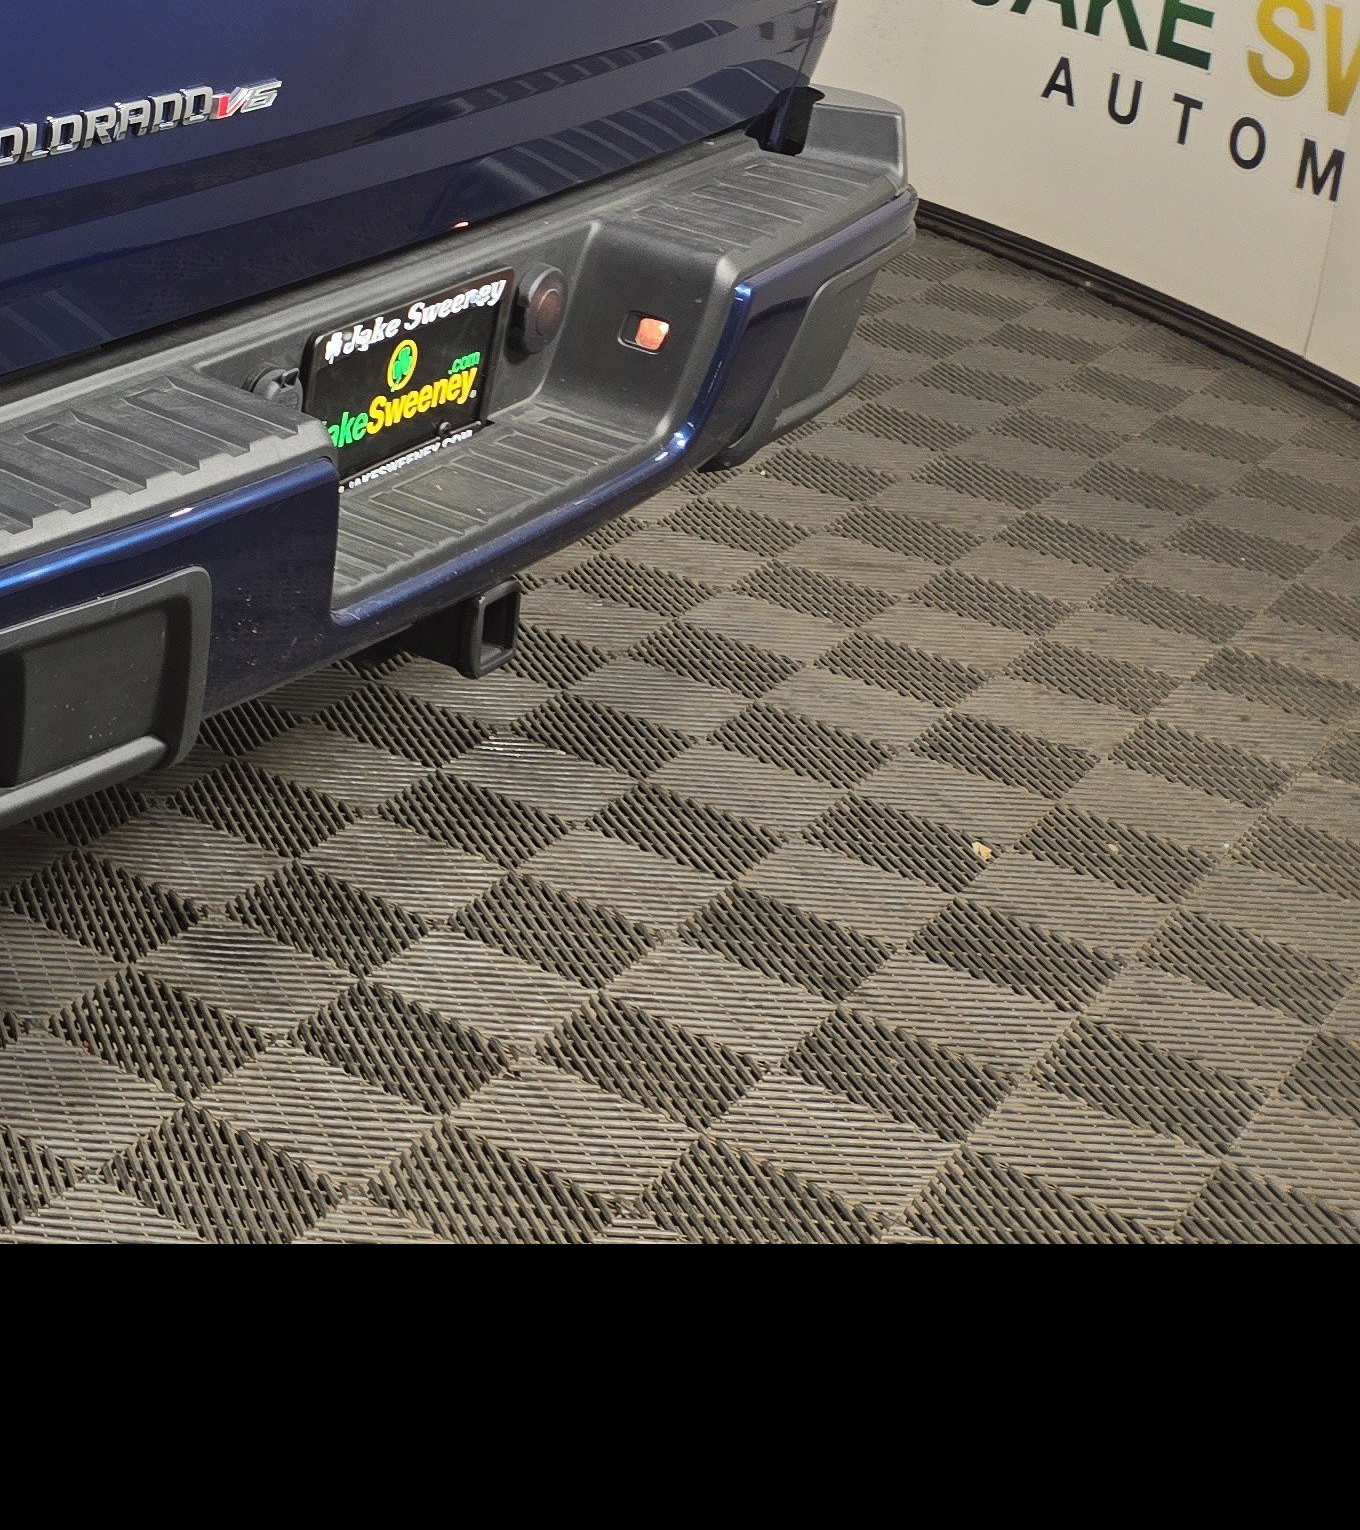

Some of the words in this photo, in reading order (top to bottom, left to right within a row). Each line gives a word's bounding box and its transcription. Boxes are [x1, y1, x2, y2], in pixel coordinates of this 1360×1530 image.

[211, 78, 283, 120] V6
[343, 317, 401, 353] Jake
[404, 279, 507, 331] Sweeney
[325, 368, 478, 448] akeSweeney
